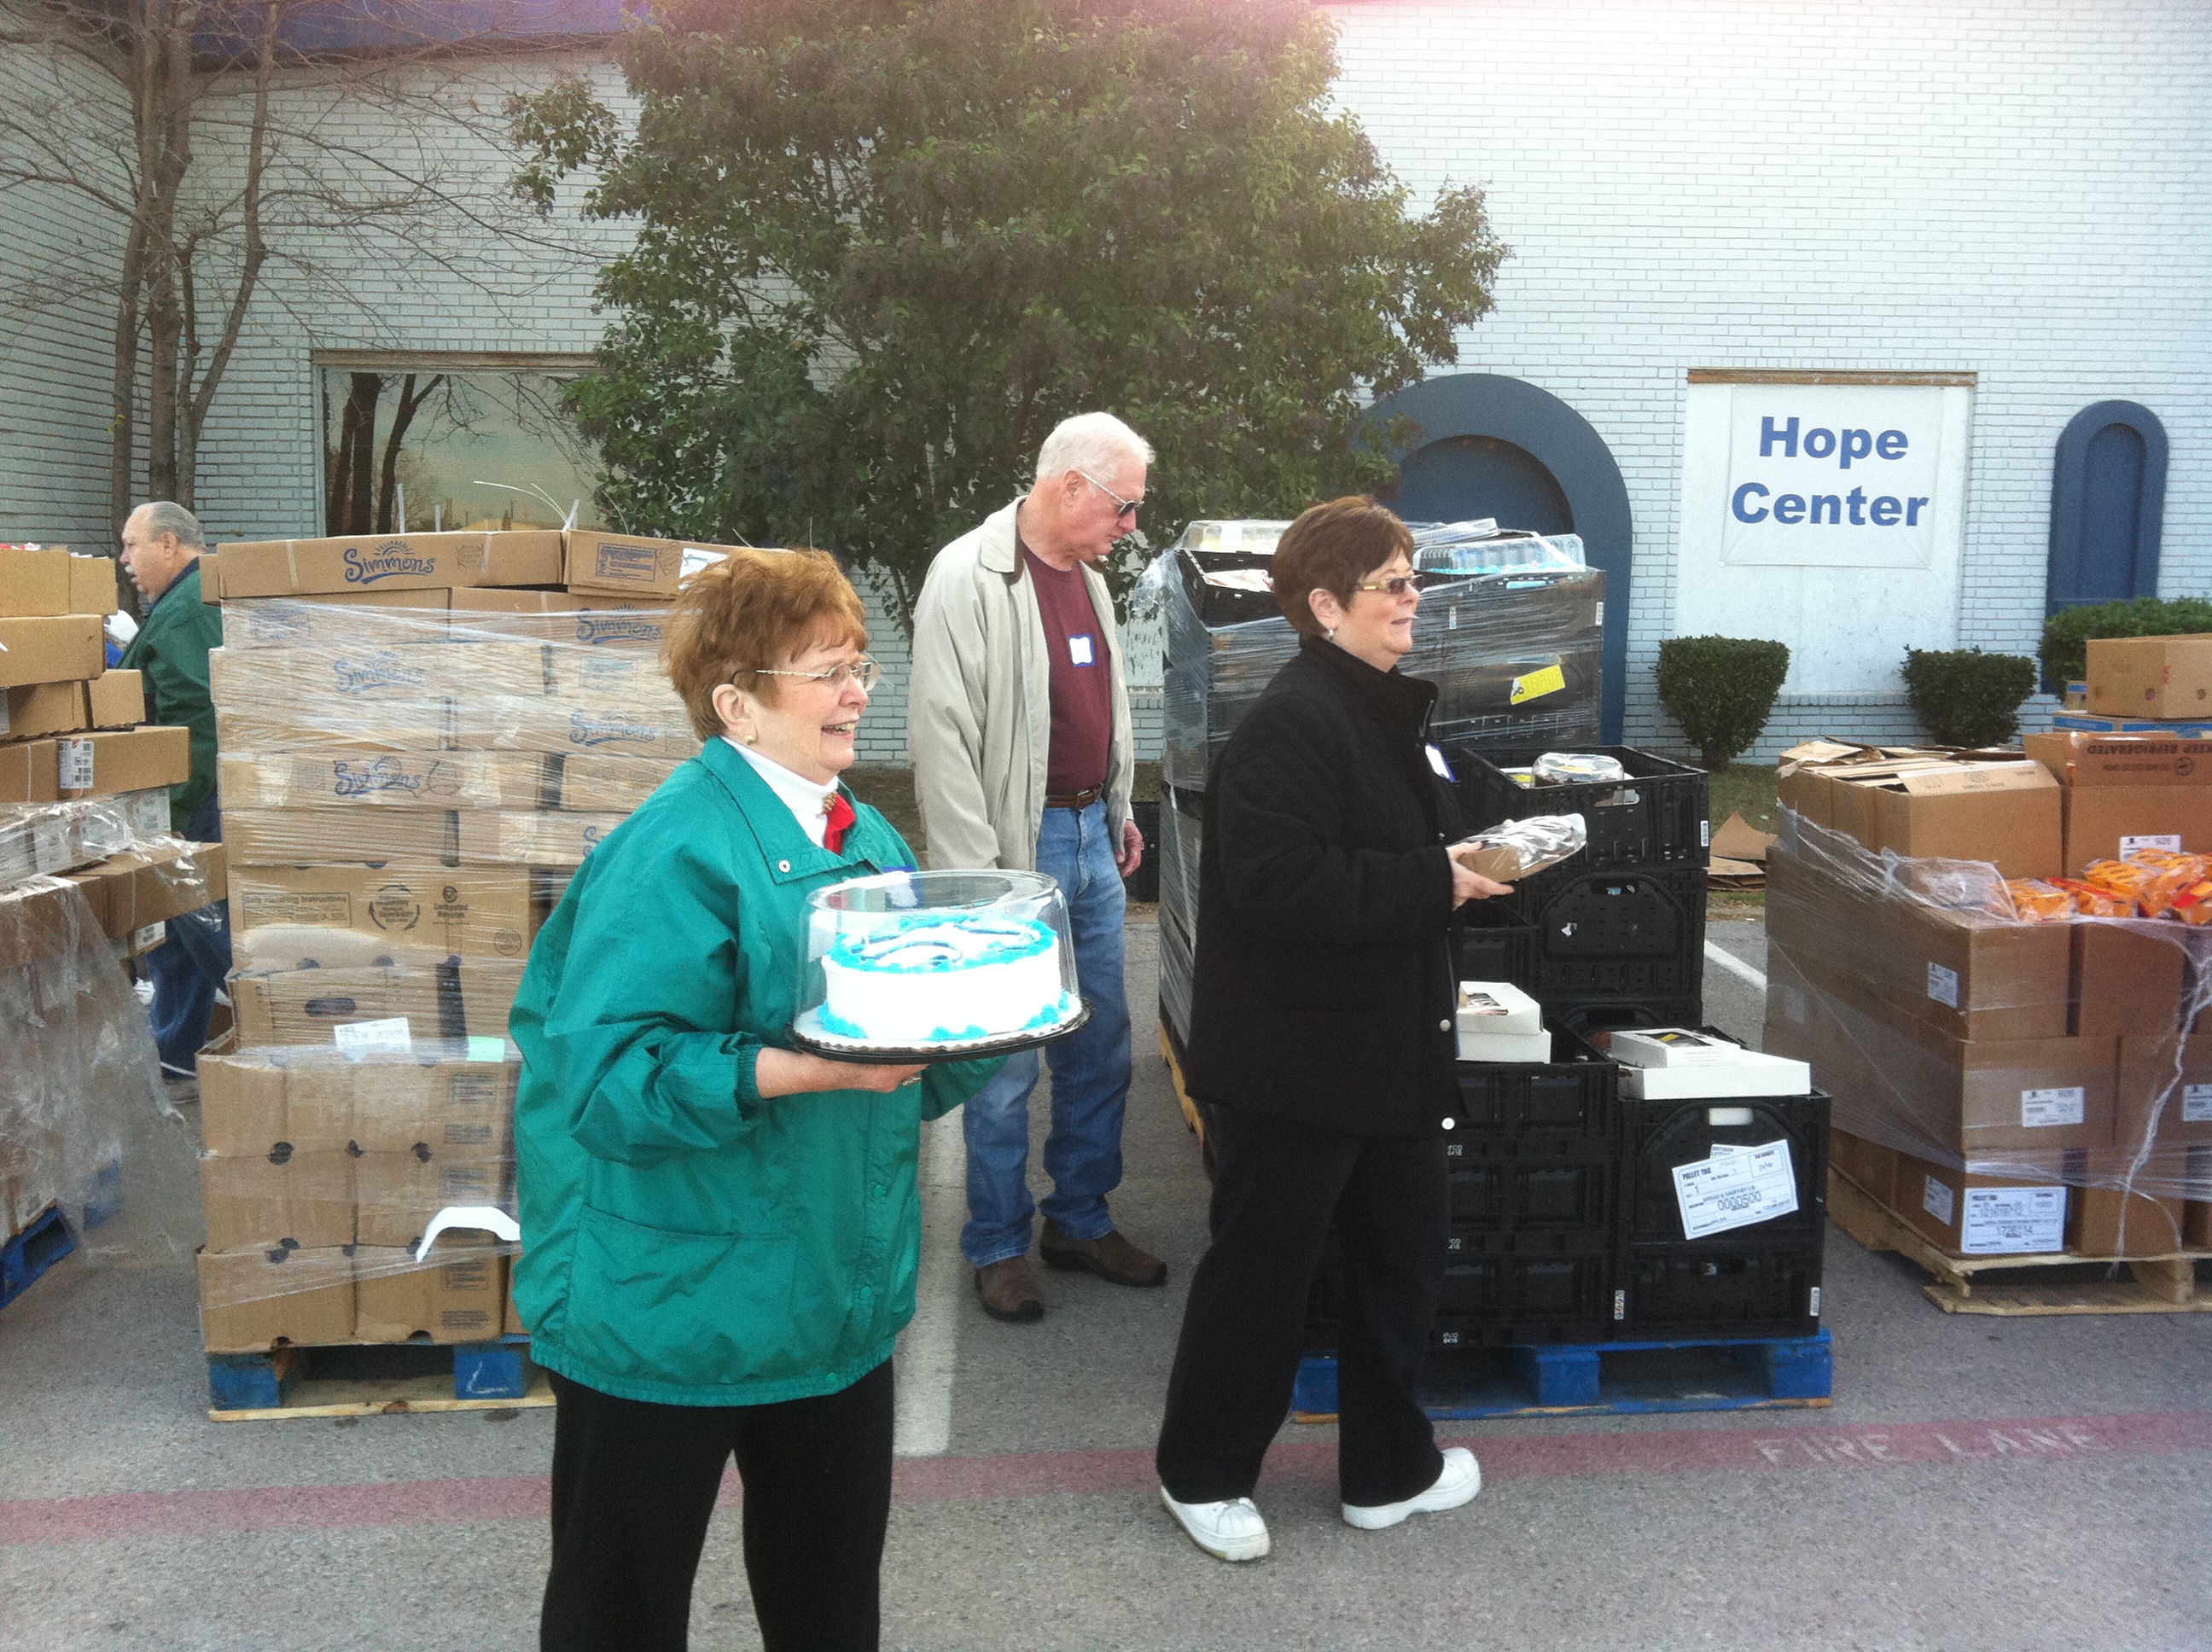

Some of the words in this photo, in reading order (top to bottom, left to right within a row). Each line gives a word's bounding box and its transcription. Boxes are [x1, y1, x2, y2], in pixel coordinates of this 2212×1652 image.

[1759, 416, 1909, 469] Hope
[1732, 482, 1930, 526] Center
[343, 548, 437, 583] Simmons
[335, 762, 420, 794] Simmons
[1682, 1169, 1700, 1180] PALLET
[1717, 1191, 1761, 1211] 0000500
[1754, 1433, 1899, 1463] FIRE
[1934, 1424, 2104, 1457] LANE
